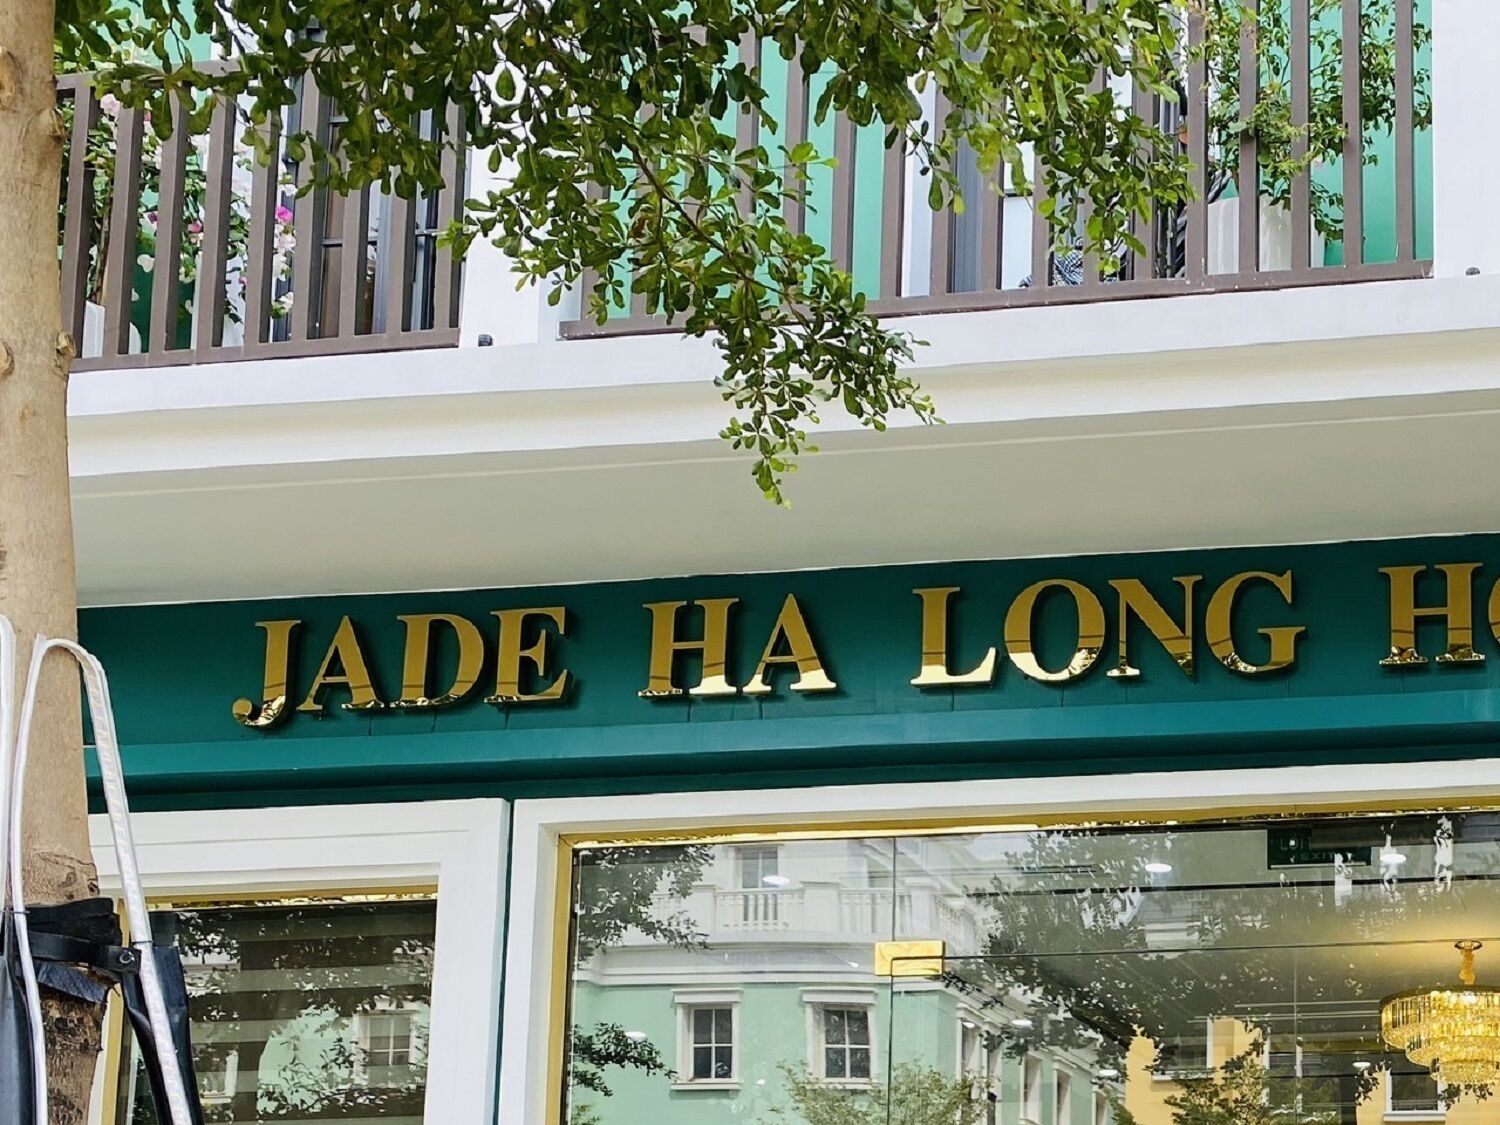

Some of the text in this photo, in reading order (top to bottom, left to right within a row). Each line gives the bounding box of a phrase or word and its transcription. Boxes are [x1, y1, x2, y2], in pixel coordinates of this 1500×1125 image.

[232, 606, 568, 726] JADE
[637, 593, 837, 697] HA
[910, 569, 1306, 687] LONG
[1300, 851, 1334, 861] EXIT
